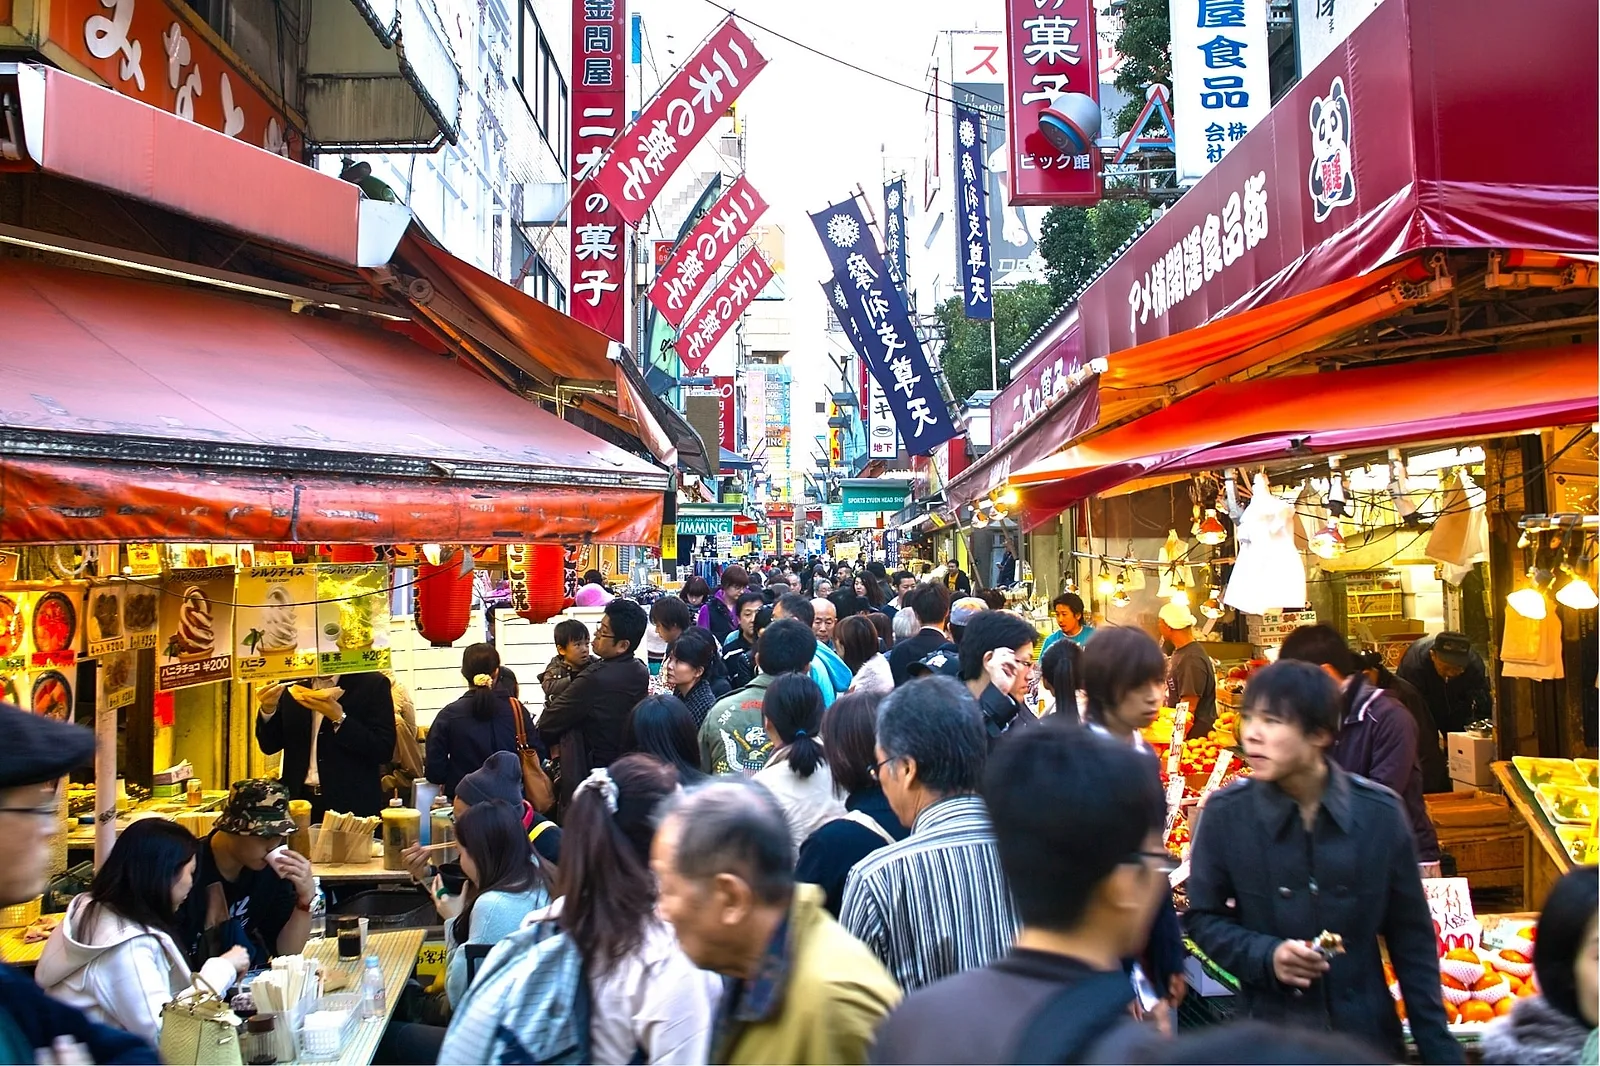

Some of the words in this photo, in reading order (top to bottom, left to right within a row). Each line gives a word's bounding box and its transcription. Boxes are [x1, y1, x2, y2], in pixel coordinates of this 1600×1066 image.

[1020, 153, 1091, 170] ビック館
[873, 443, 893, 453] 地下
[251, 567, 305, 578] シルクアイス
[161, 662, 201, 677] バニラチョコ
[203, 657, 229, 672] ¥200
[240, 657, 267, 668] バニラ
